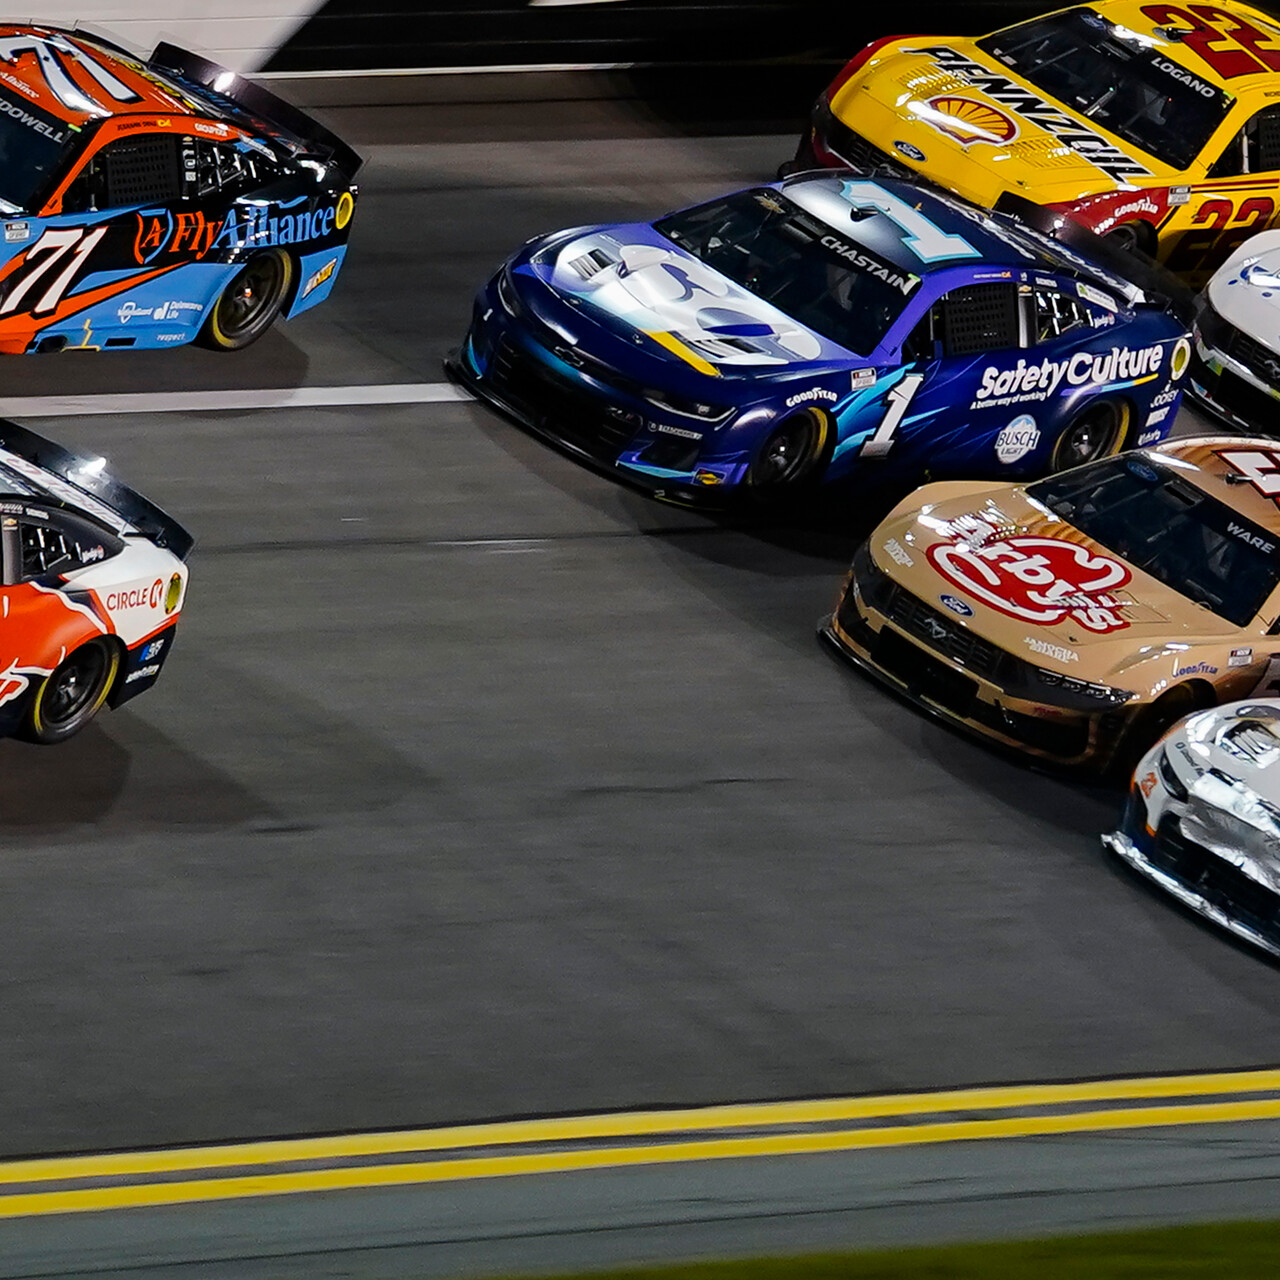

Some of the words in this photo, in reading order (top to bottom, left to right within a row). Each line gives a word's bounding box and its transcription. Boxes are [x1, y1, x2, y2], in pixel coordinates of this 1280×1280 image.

[1150, 56, 1215, 99] LOGANO
[898, 45, 1156, 186] PENNZOIL
[169, 206, 335, 260] FlyAlliance
[839, 179, 984, 264] 1
[1114, 198, 1158, 217] GOODYEAR
[0, 225, 109, 316] 71
[821, 235, 910, 296] CHASTAIN
[785, 387, 838, 408] GOODYEAR
[976, 345, 1164, 398] SafetyCulture
[859, 373, 924, 459] 1
[995, 430, 1041, 452] BUSCH
[1226, 521, 1275, 554] WARE
[106, 587, 148, 611] CIRCLE
